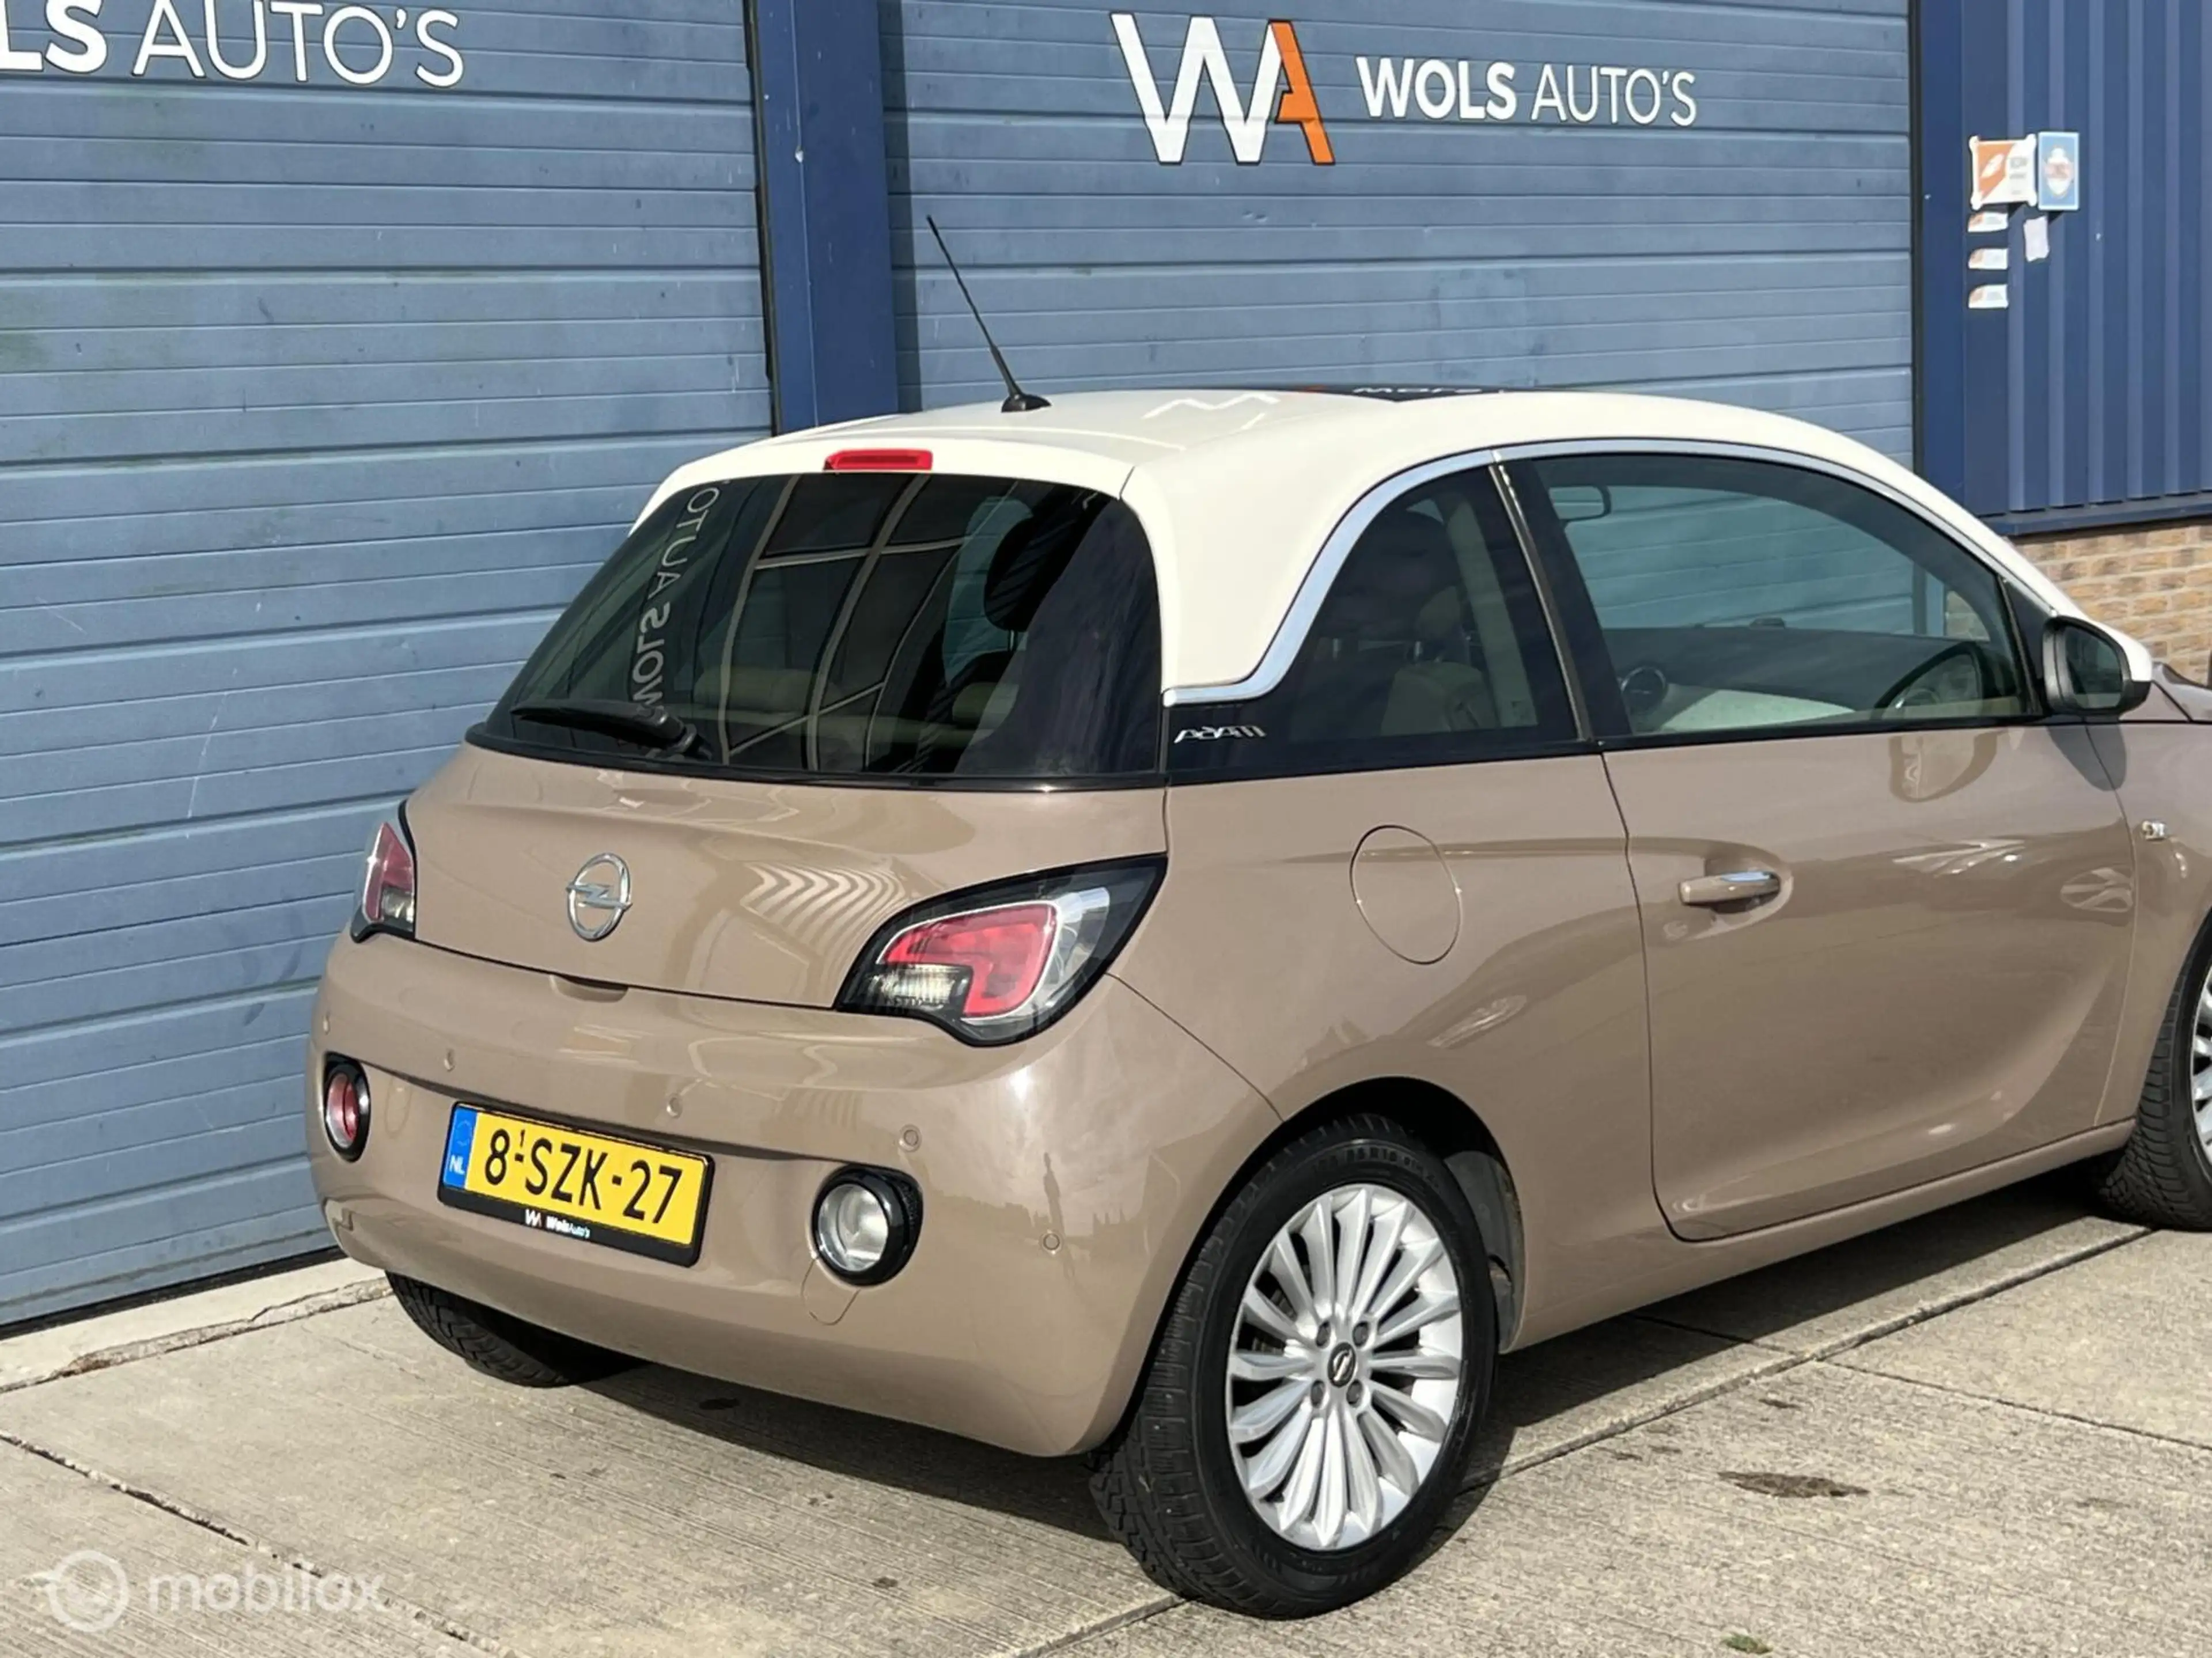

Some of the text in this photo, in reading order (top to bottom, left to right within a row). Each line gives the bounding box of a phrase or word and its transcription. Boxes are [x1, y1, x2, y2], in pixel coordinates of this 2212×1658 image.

[132, 0, 464, 88] AUTO'S
[1355, 56, 1698, 127] WOLS AUTO'S
[449, 1154, 465, 1175] NL
